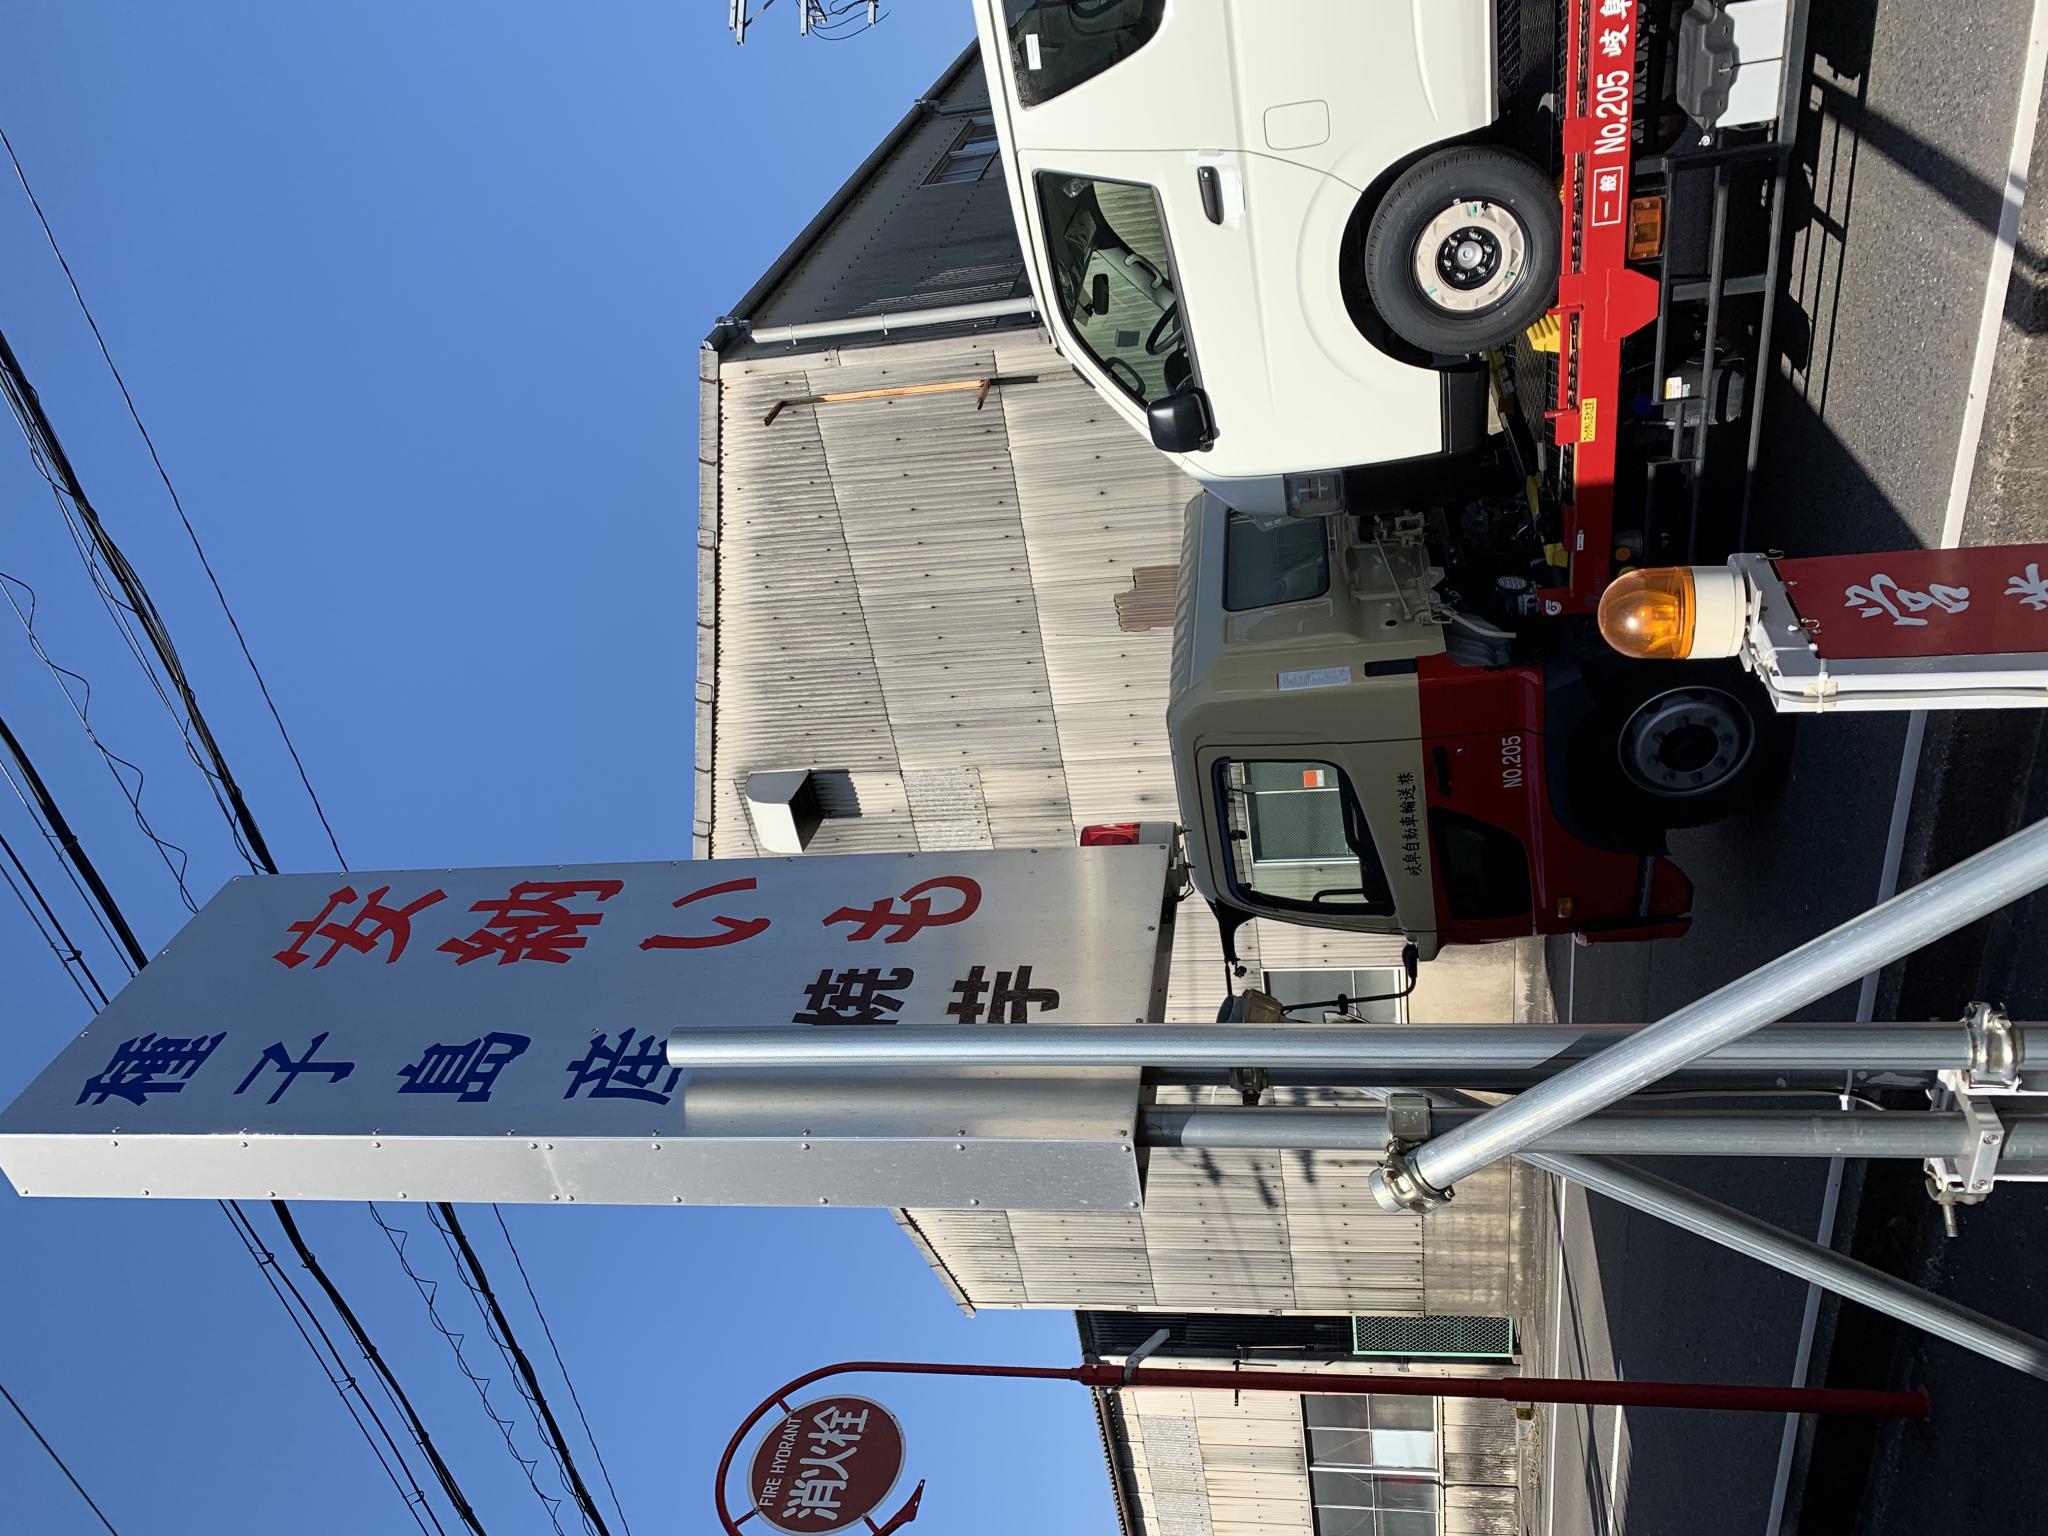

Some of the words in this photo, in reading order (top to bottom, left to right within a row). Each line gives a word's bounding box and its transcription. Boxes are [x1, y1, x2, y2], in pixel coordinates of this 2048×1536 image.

[1593, 70, 1630, 155] No.205
[1599, 173, 1618, 219] 一般
[1502, 735, 1523, 788] NO.205
[272, 875, 983, 969] 安納いも
[792, 965, 1059, 1025] 焼芋
[75, 1027, 682, 1106] 種子島産
[769, 1416, 803, 1474] HYDRANT
[782, 1406, 869, 1520] 消火栓
[758, 1478, 782, 1506] FIRE
